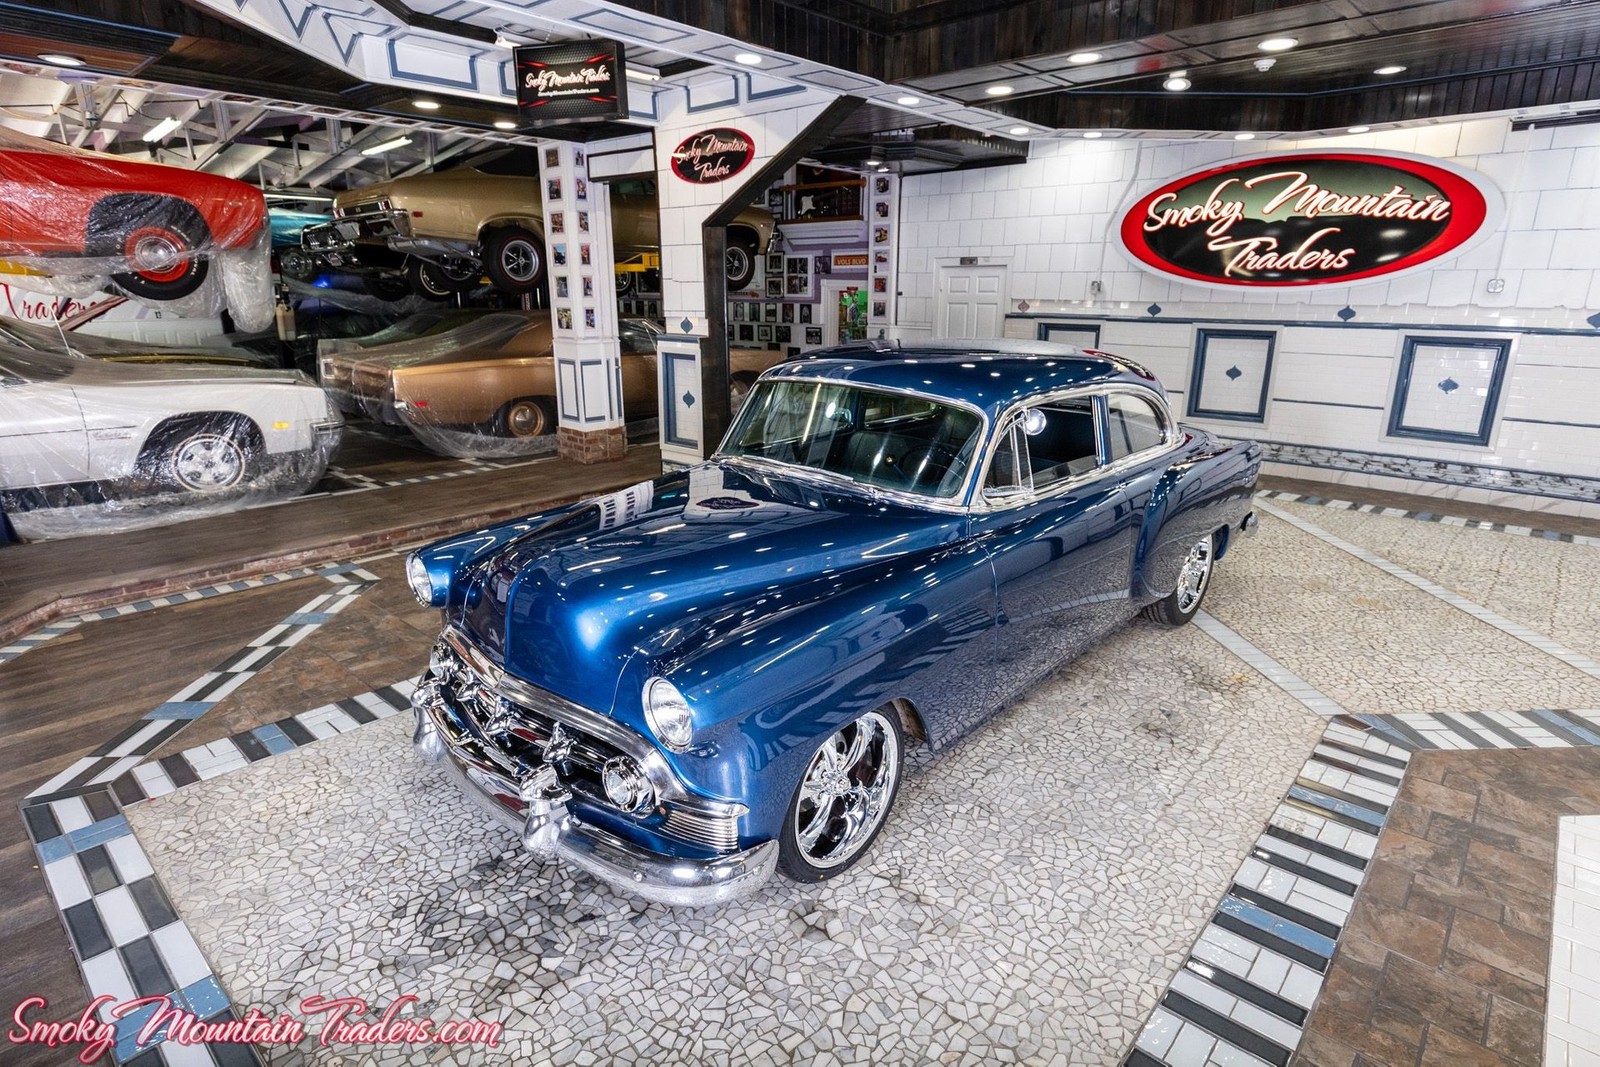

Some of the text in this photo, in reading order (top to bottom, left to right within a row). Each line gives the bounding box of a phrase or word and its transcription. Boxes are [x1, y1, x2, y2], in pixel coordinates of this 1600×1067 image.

[700, 134, 748, 153] Mountain
[694, 157, 730, 181] Traders
[1143, 171, 1451, 236] Smoky Mountain
[1207, 228, 1355, 277] Traders
